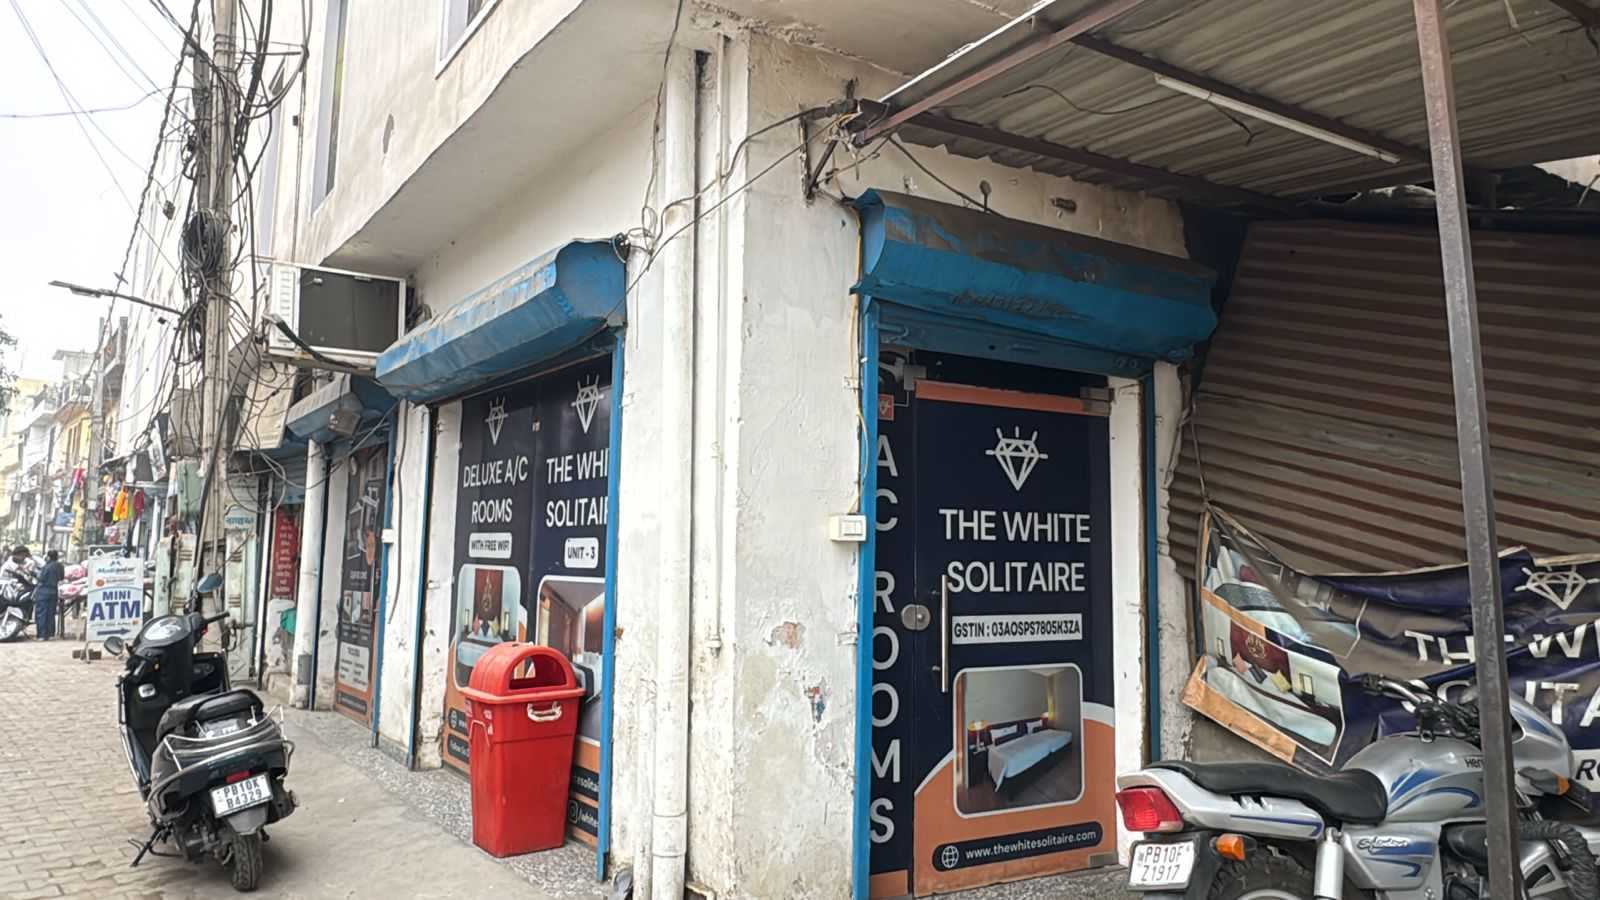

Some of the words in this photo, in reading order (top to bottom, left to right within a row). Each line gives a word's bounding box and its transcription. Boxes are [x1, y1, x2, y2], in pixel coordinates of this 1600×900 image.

[463, 460, 503, 488] DELUXE
[504, 455, 528, 486] A/C
[546, 455, 572, 484] THE
[472, 498, 513, 523] ROOMS
[939, 508, 996, 540] THE
[1003, 511, 1091, 543] WHITE
[485, 540, 497, 551] FREE
[567, 547, 584, 559] UNIT
[947, 560, 1085, 593] SOLITAIRE
[102, 590, 131, 601] MINI
[90, 600, 141, 621] ATM
[1576, 759, 1600, 781] R
[223, 779, 260, 798] PB10K
[965, 830, 1097, 860] www.thewhitesolitaire.com
[1144, 846, 1184, 864] PB10F
[1141, 864, 1180, 881] Z1917
